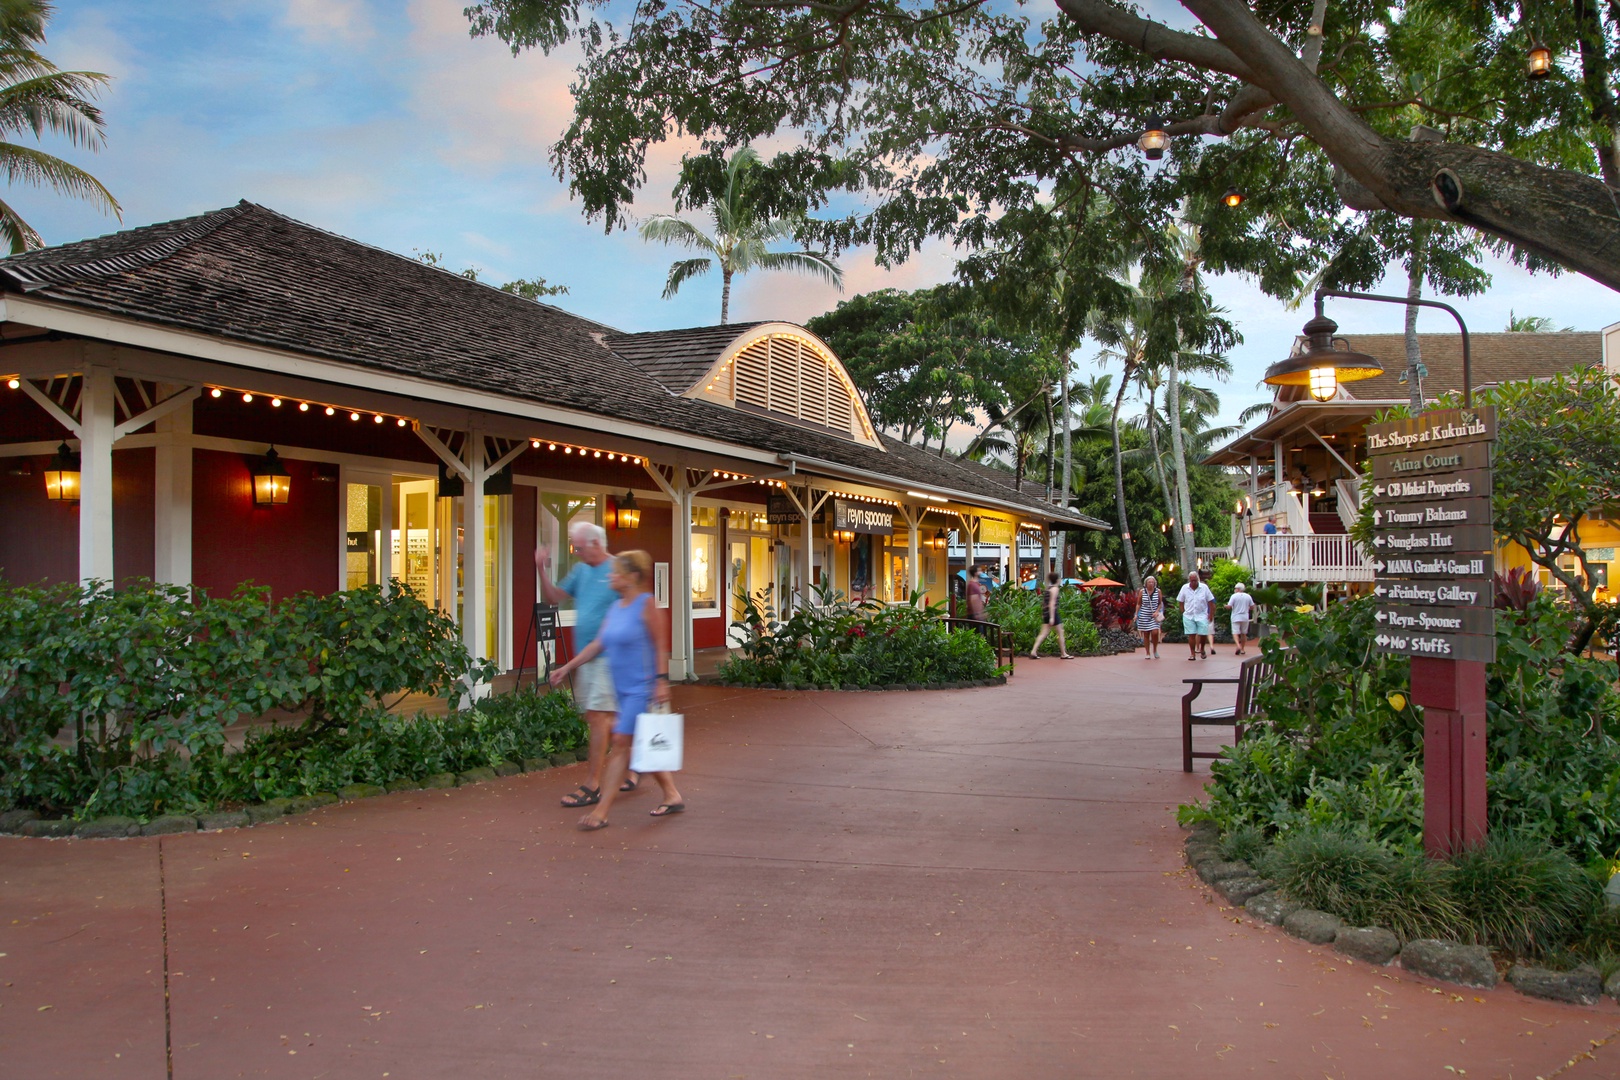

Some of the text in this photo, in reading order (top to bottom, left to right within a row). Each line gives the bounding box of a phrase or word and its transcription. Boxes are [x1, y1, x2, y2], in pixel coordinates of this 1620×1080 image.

[1368, 433, 1388, 449] The
[1388, 431, 1418, 448] Shops
[1420, 430, 1430, 442] at
[1423, 454, 1460, 468] Court
[1388, 478, 1470, 496] CB Makai Properties
[769, 513, 820, 523] reyn spoer
[848, 508, 864, 528] reyn
[864, 512, 892, 530] spooner
[1386, 507, 1468, 524] Tommy Bahama
[348, 537, 358, 546] hut
[1387, 532, 1452, 550] Sunglass Hut
[1387, 560, 1413, 574] MANA
[1448, 560, 1470, 574] Gems
[1470, 560, 1484, 574] HI
[1388, 584, 1478, 604] aFeinberg Gallery
[1388, 611, 1462, 630] Reyn-Spooner
[1390, 636, 1452, 654] Mo' Stuffs
